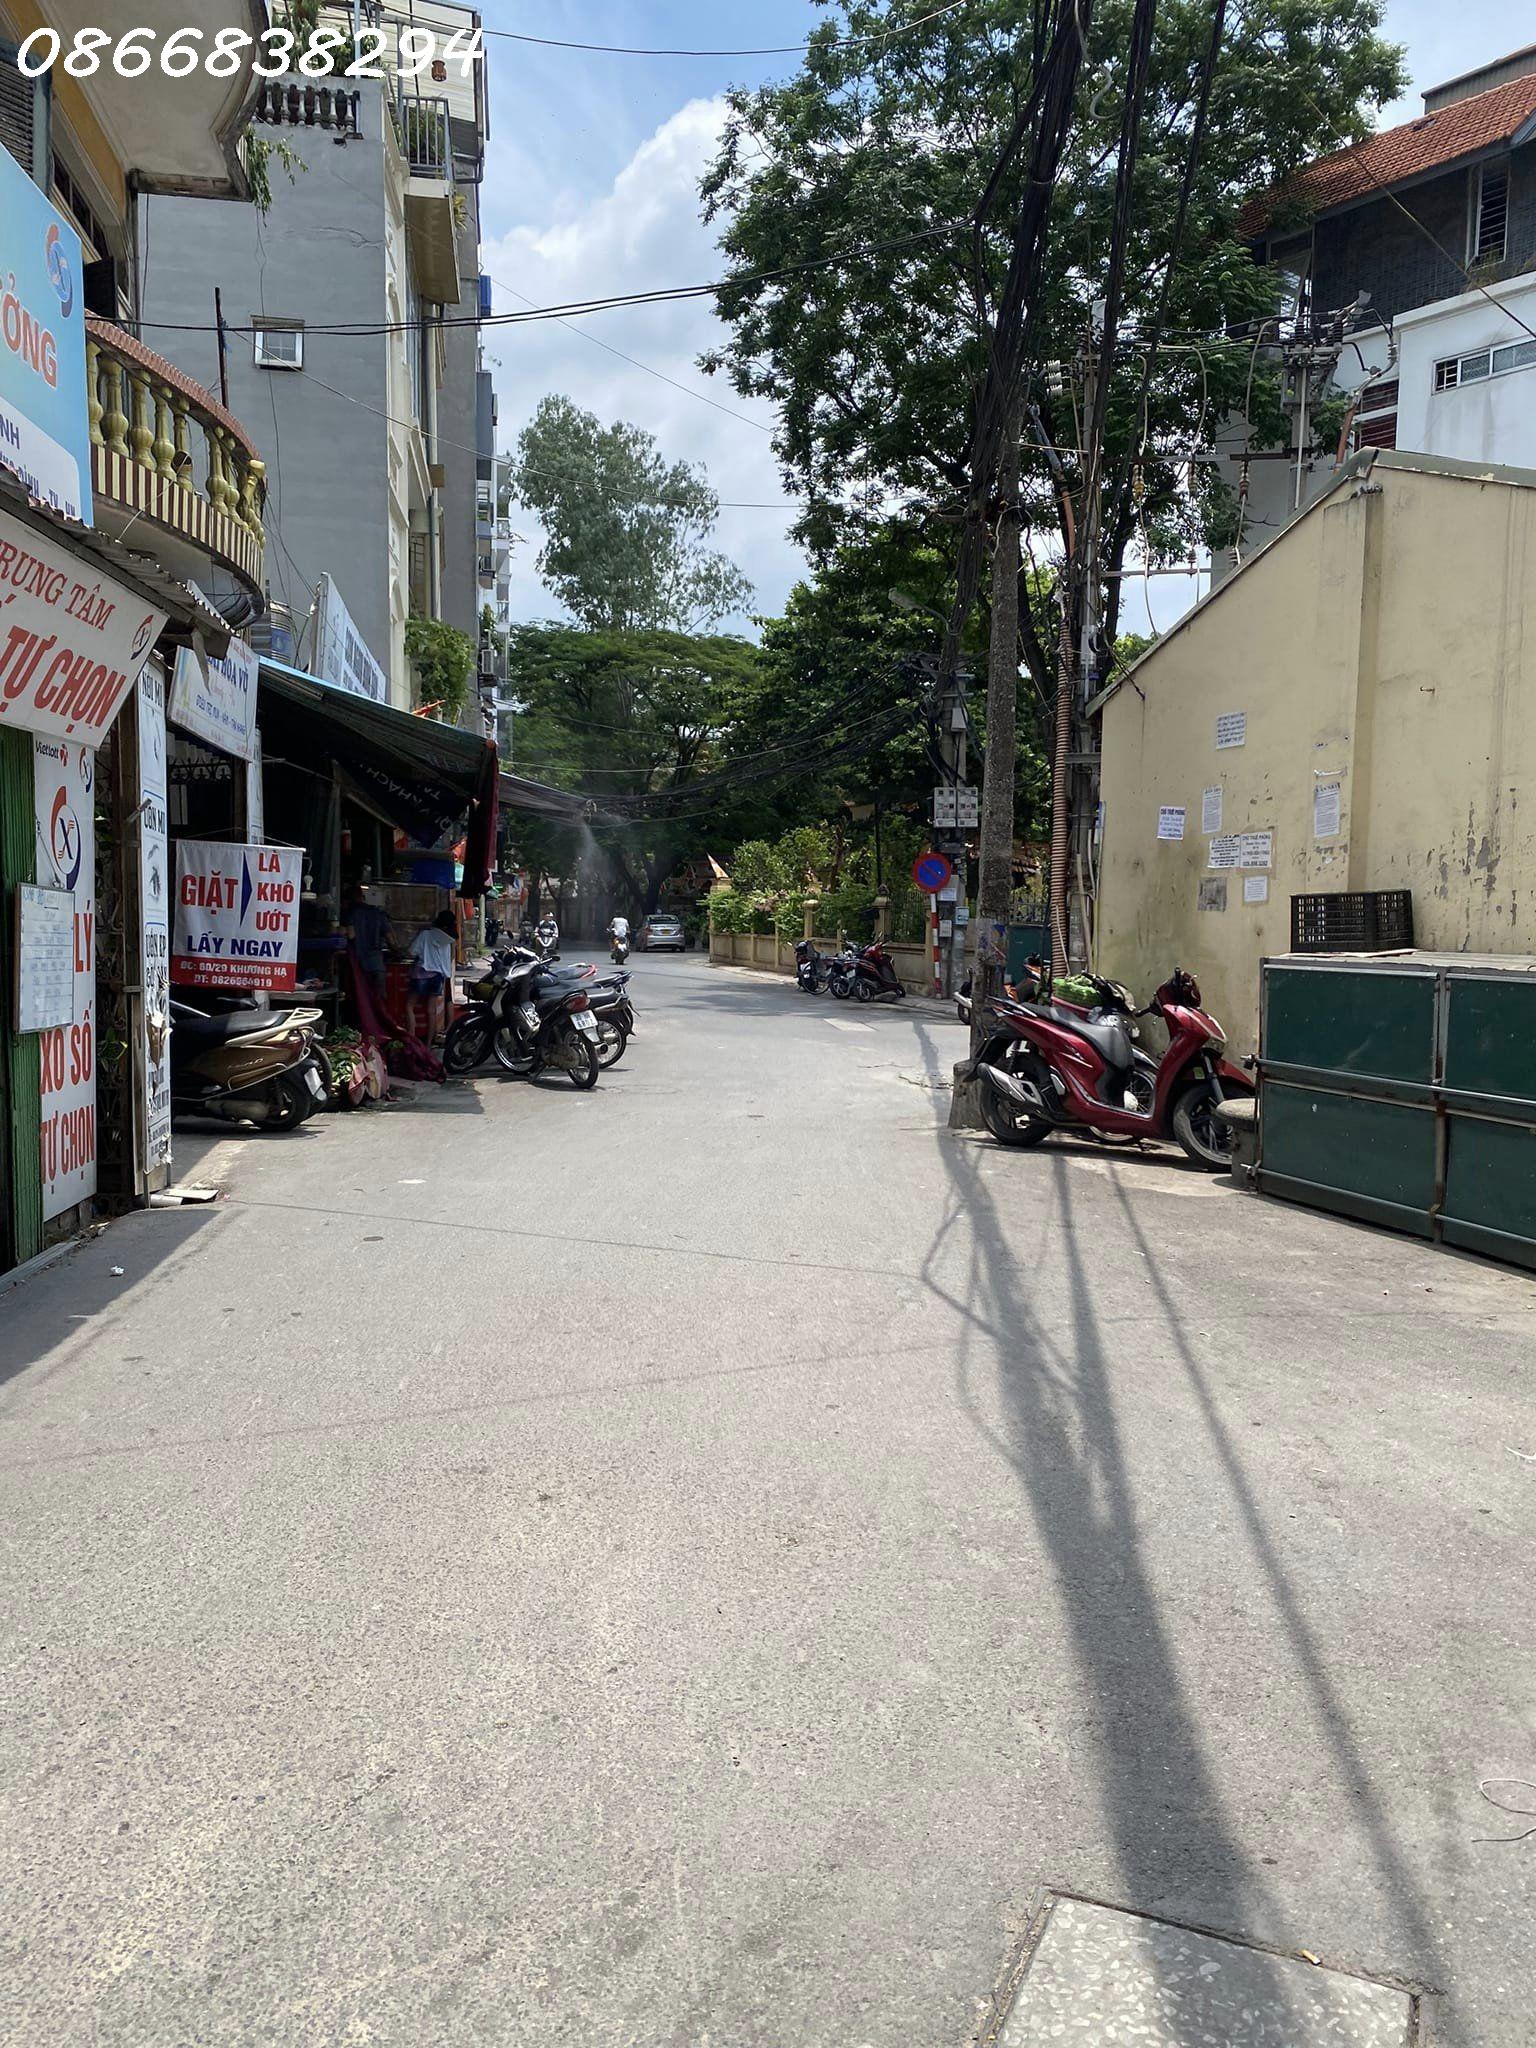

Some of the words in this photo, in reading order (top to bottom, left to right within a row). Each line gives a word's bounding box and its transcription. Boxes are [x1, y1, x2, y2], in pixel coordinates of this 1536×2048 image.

[0, 271, 57, 388] ỞNG
[65, 584, 116, 631] TÂM
[0, 625, 57, 713] TỰ
[33, 648, 126, 733] CHỌN
[36, 740, 59, 759] Vietlott
[258, 850, 280, 873] LÀ
[181, 870, 238, 915] GIẶT
[257, 880, 295, 904] KHÔ
[256, 908, 292, 933] ƯỚT
[187, 931, 225, 955] LẤY
[230, 938, 284, 958] NGAY
[71, 999, 93, 1086] SỐ
[61, 1103, 94, 1181] CHỌN
